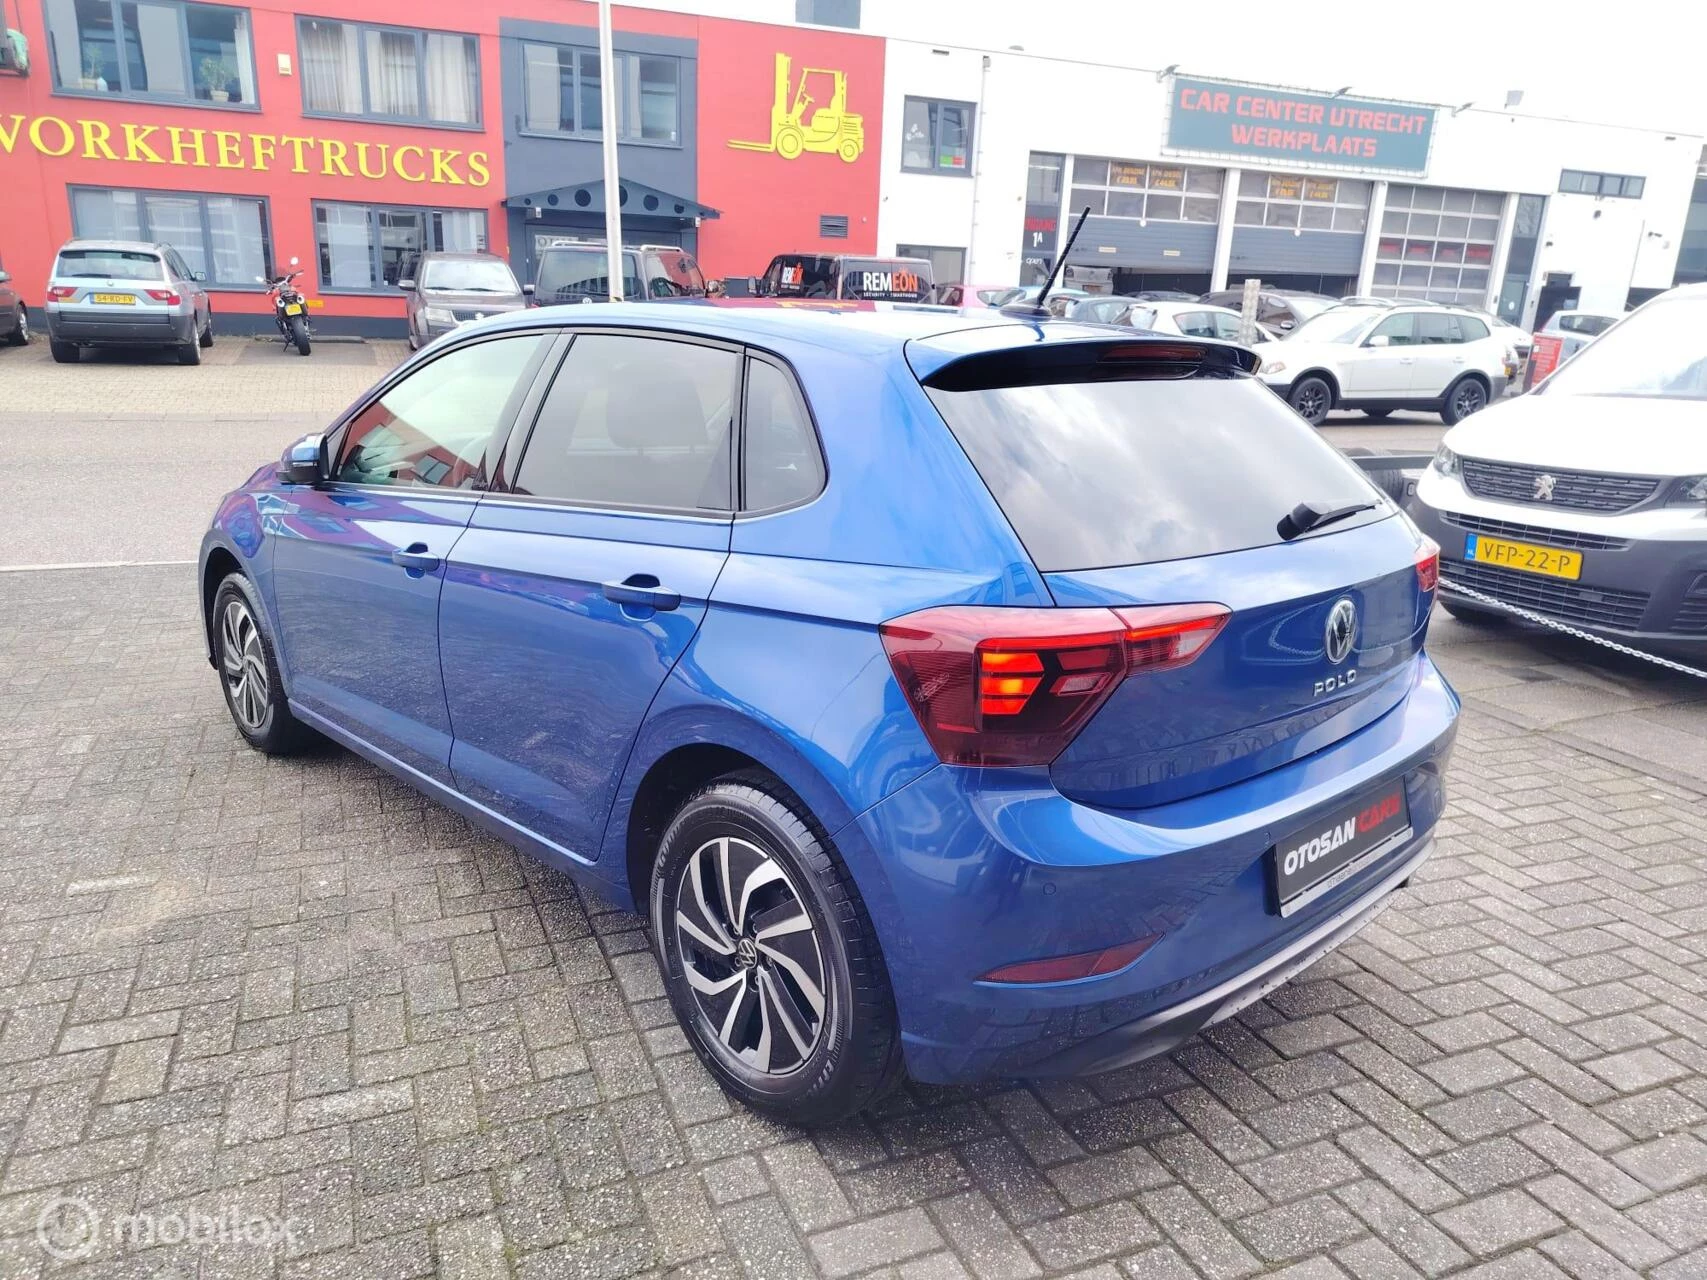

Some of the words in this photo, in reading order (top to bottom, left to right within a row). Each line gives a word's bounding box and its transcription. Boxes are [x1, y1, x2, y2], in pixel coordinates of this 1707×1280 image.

[1180, 88, 1229, 113] CAR
[1236, 95, 1324, 125] CENTER
[1329, 106, 1427, 135] UTRECHT
[1231, 124, 1378, 158] WERKPLAATS
[1033, 231, 1043, 248] 1A
[863, 269, 918, 292] REMEON
[1484, 542, 1571, 572] VFP-22-P
[1313, 669, 1357, 697] POLO
[1284, 816, 1356, 876] OTOSAN
